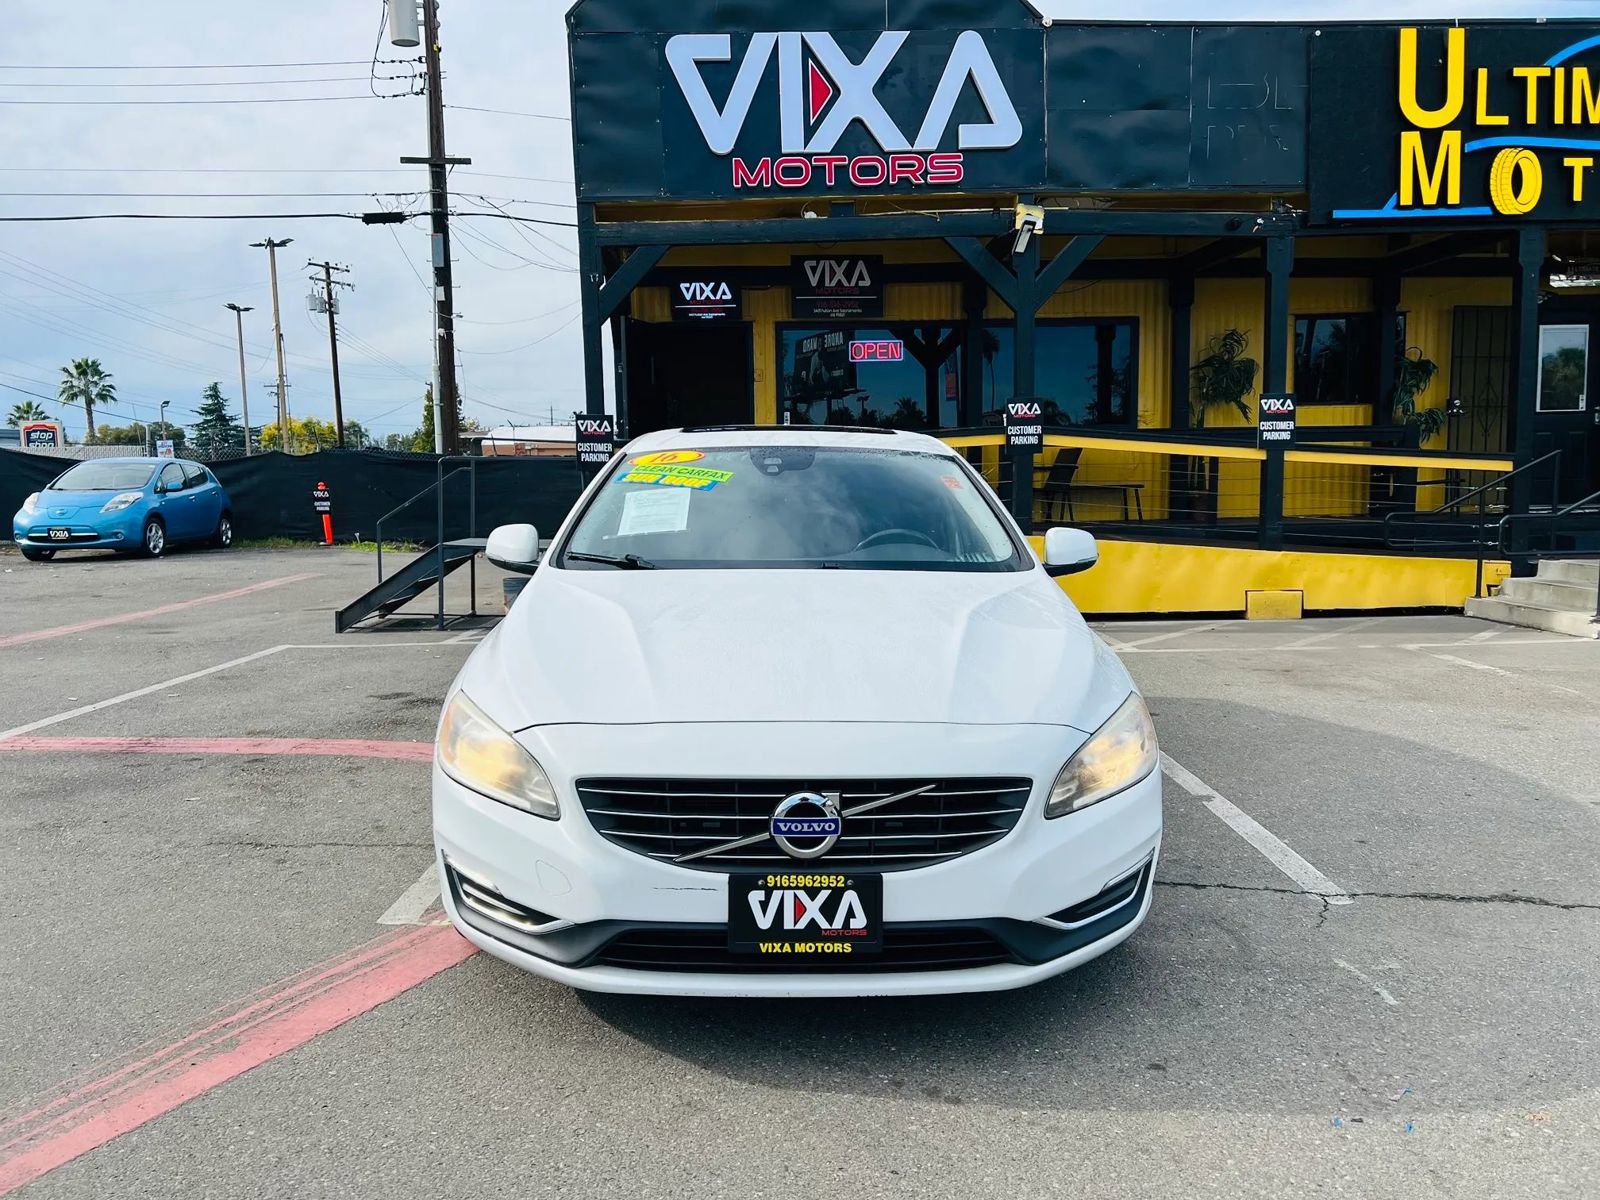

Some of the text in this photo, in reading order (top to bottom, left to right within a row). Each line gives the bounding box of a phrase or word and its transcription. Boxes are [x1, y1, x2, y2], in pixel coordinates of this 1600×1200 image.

[665, 30, 1023, 155] VIXA
[732, 153, 964, 188] MOTORS
[804, 260, 871, 287] VIXA
[680, 282, 732, 300] VIXA
[851, 342, 901, 360] OPEN
[1008, 403, 1041, 415] VIXA
[1260, 399, 1294, 410] VIXA
[577, 420, 612, 432] VIXA
[1008, 426, 1042, 435] CUSTOMER
[1260, 421, 1294, 430] CUSTOMER
[30, 431, 53, 440] stop
[1010, 435, 1039, 445] PARKING
[1263, 431, 1291, 440] PARKING
[577, 443, 613, 452] CUSTOMER
[581, 453, 610, 462] PARKING
[635, 465, 675, 474] CLEAN
[677, 468, 729, 480] CARFAX
[777, 822, 836, 832] VOLVO
[767, 875, 845, 888] 9165962952
[747, 889, 868, 930] VIXA
[759, 943, 852, 953] VIXA MOTORS
